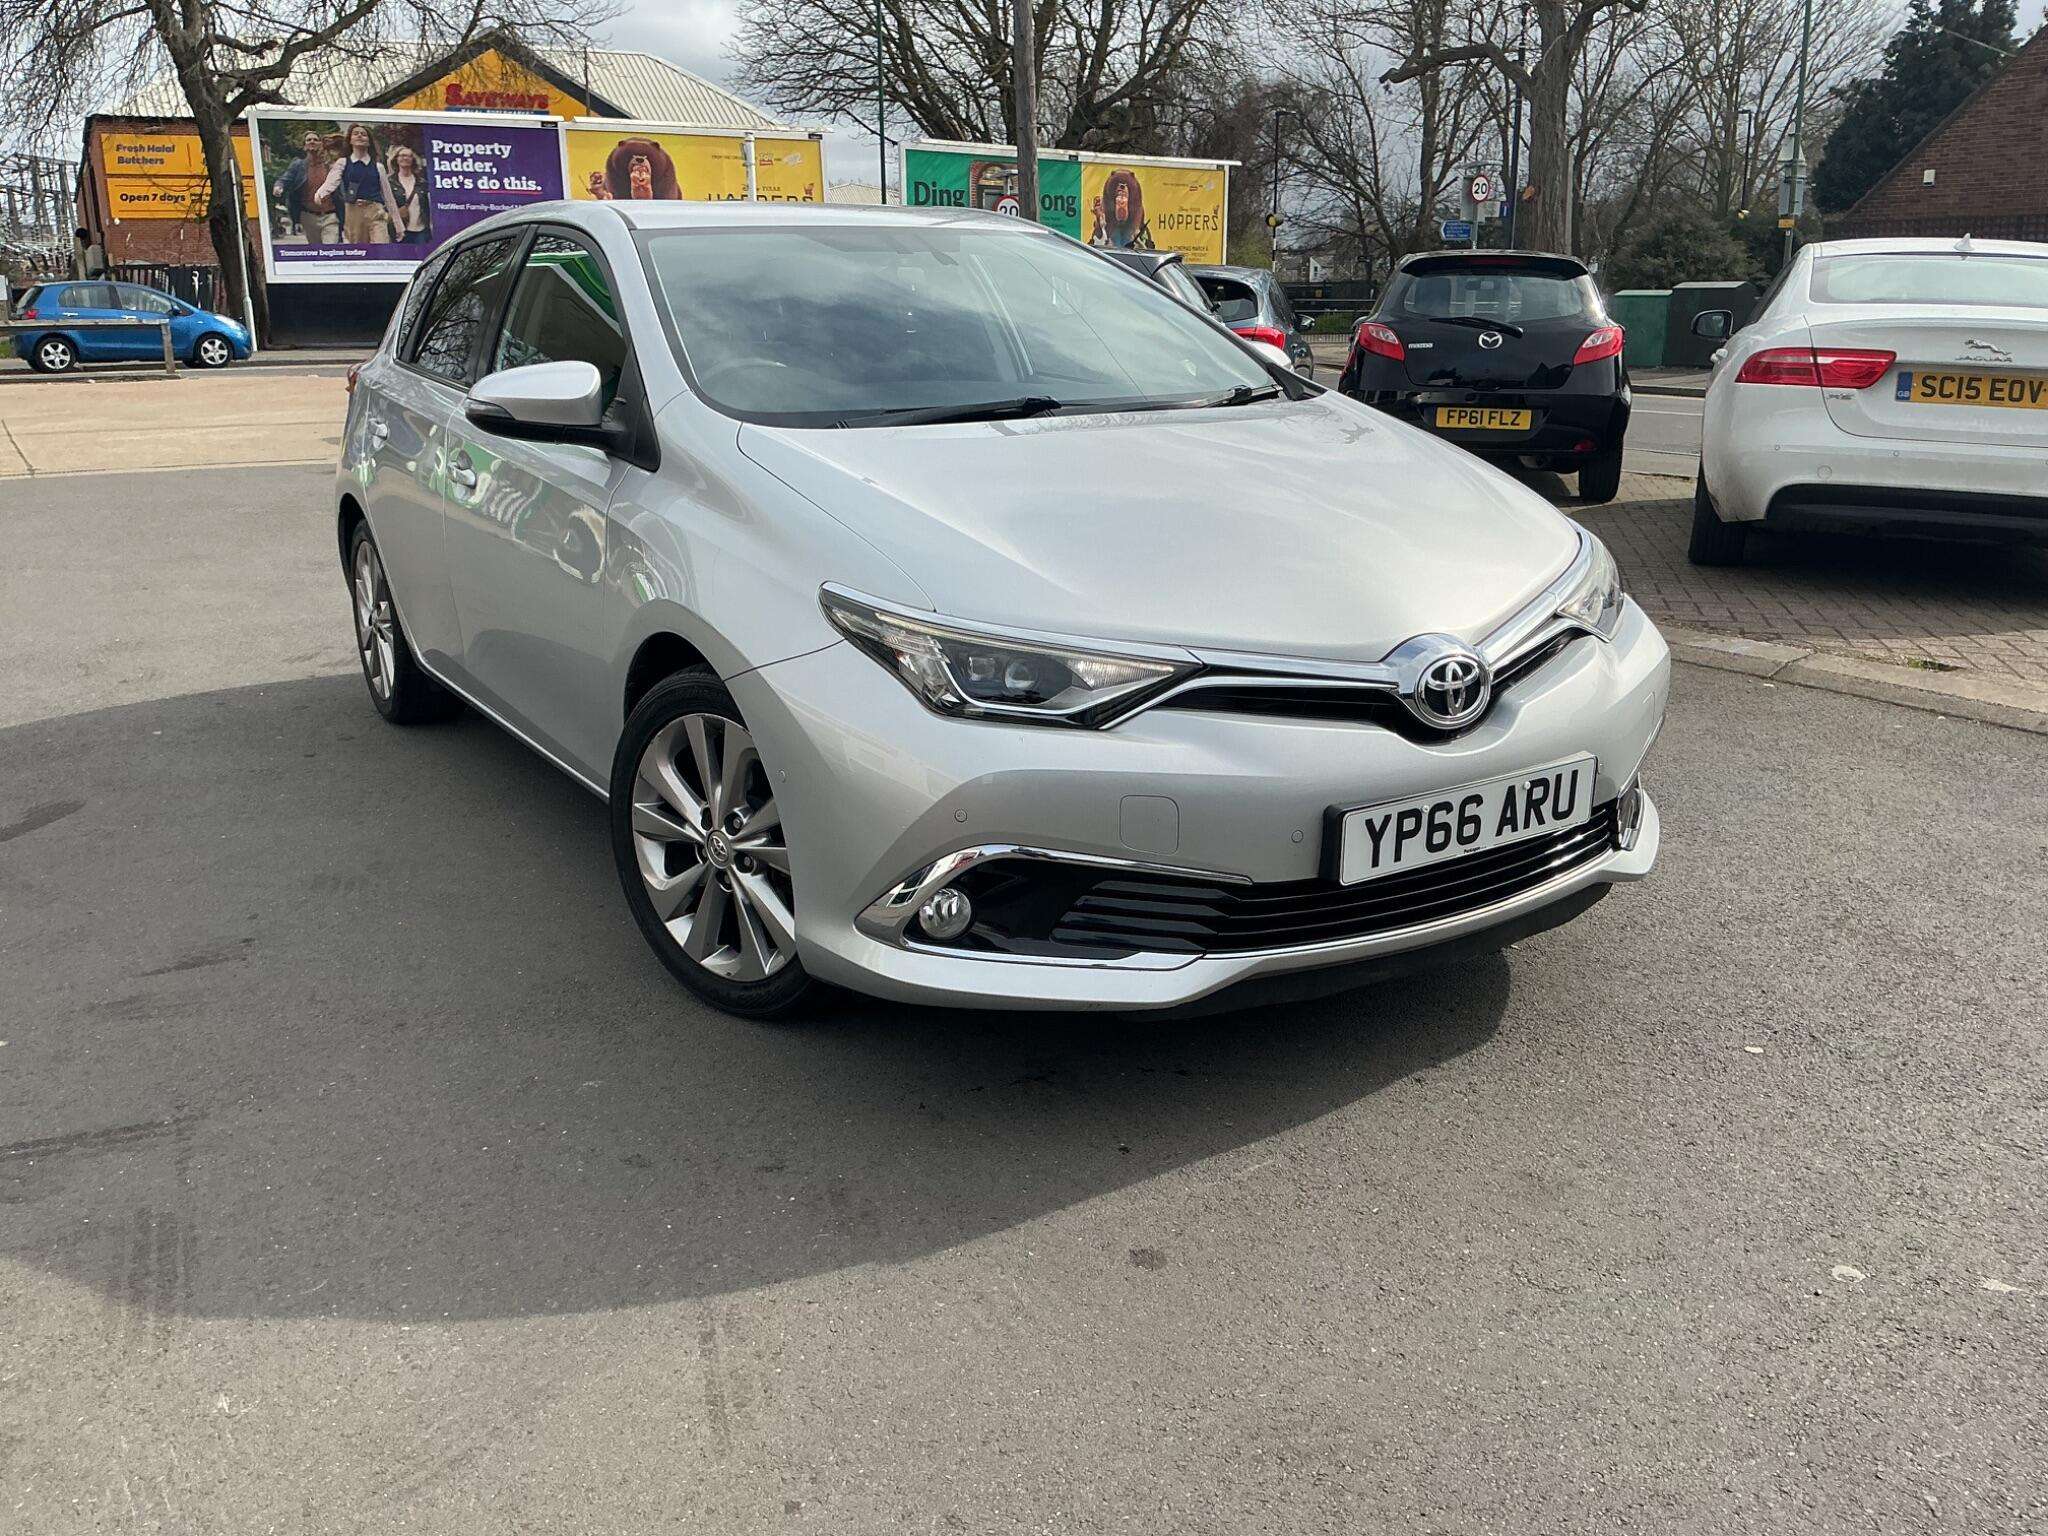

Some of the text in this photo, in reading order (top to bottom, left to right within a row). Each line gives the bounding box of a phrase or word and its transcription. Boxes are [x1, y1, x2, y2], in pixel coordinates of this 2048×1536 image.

[116, 144, 175, 153] Fresh Halal
[432, 140, 512, 158] Property
[117, 156, 165, 165] Butchers
[433, 157, 497, 174] ladder,
[435, 175, 542, 191] let's do this.
[1474, 182, 1488, 195] 20
[119, 193, 149, 203] Open
[152, 193, 158, 202] 7
[160, 192, 186, 204] days
[914, 181, 966, 207] Ding
[1040, 193, 1077, 218] ong
[1158, 213, 1219, 231] HOPPERS
[319, 249, 345, 258] begins
[346, 249, 367, 257] today
[1897, 390, 1910, 398] GB
[1920, 375, 2044, 403] SC15 EOV
[1446, 409, 1521, 426] FP61 FLZ
[1364, 769, 1580, 869] YP66 ARU
